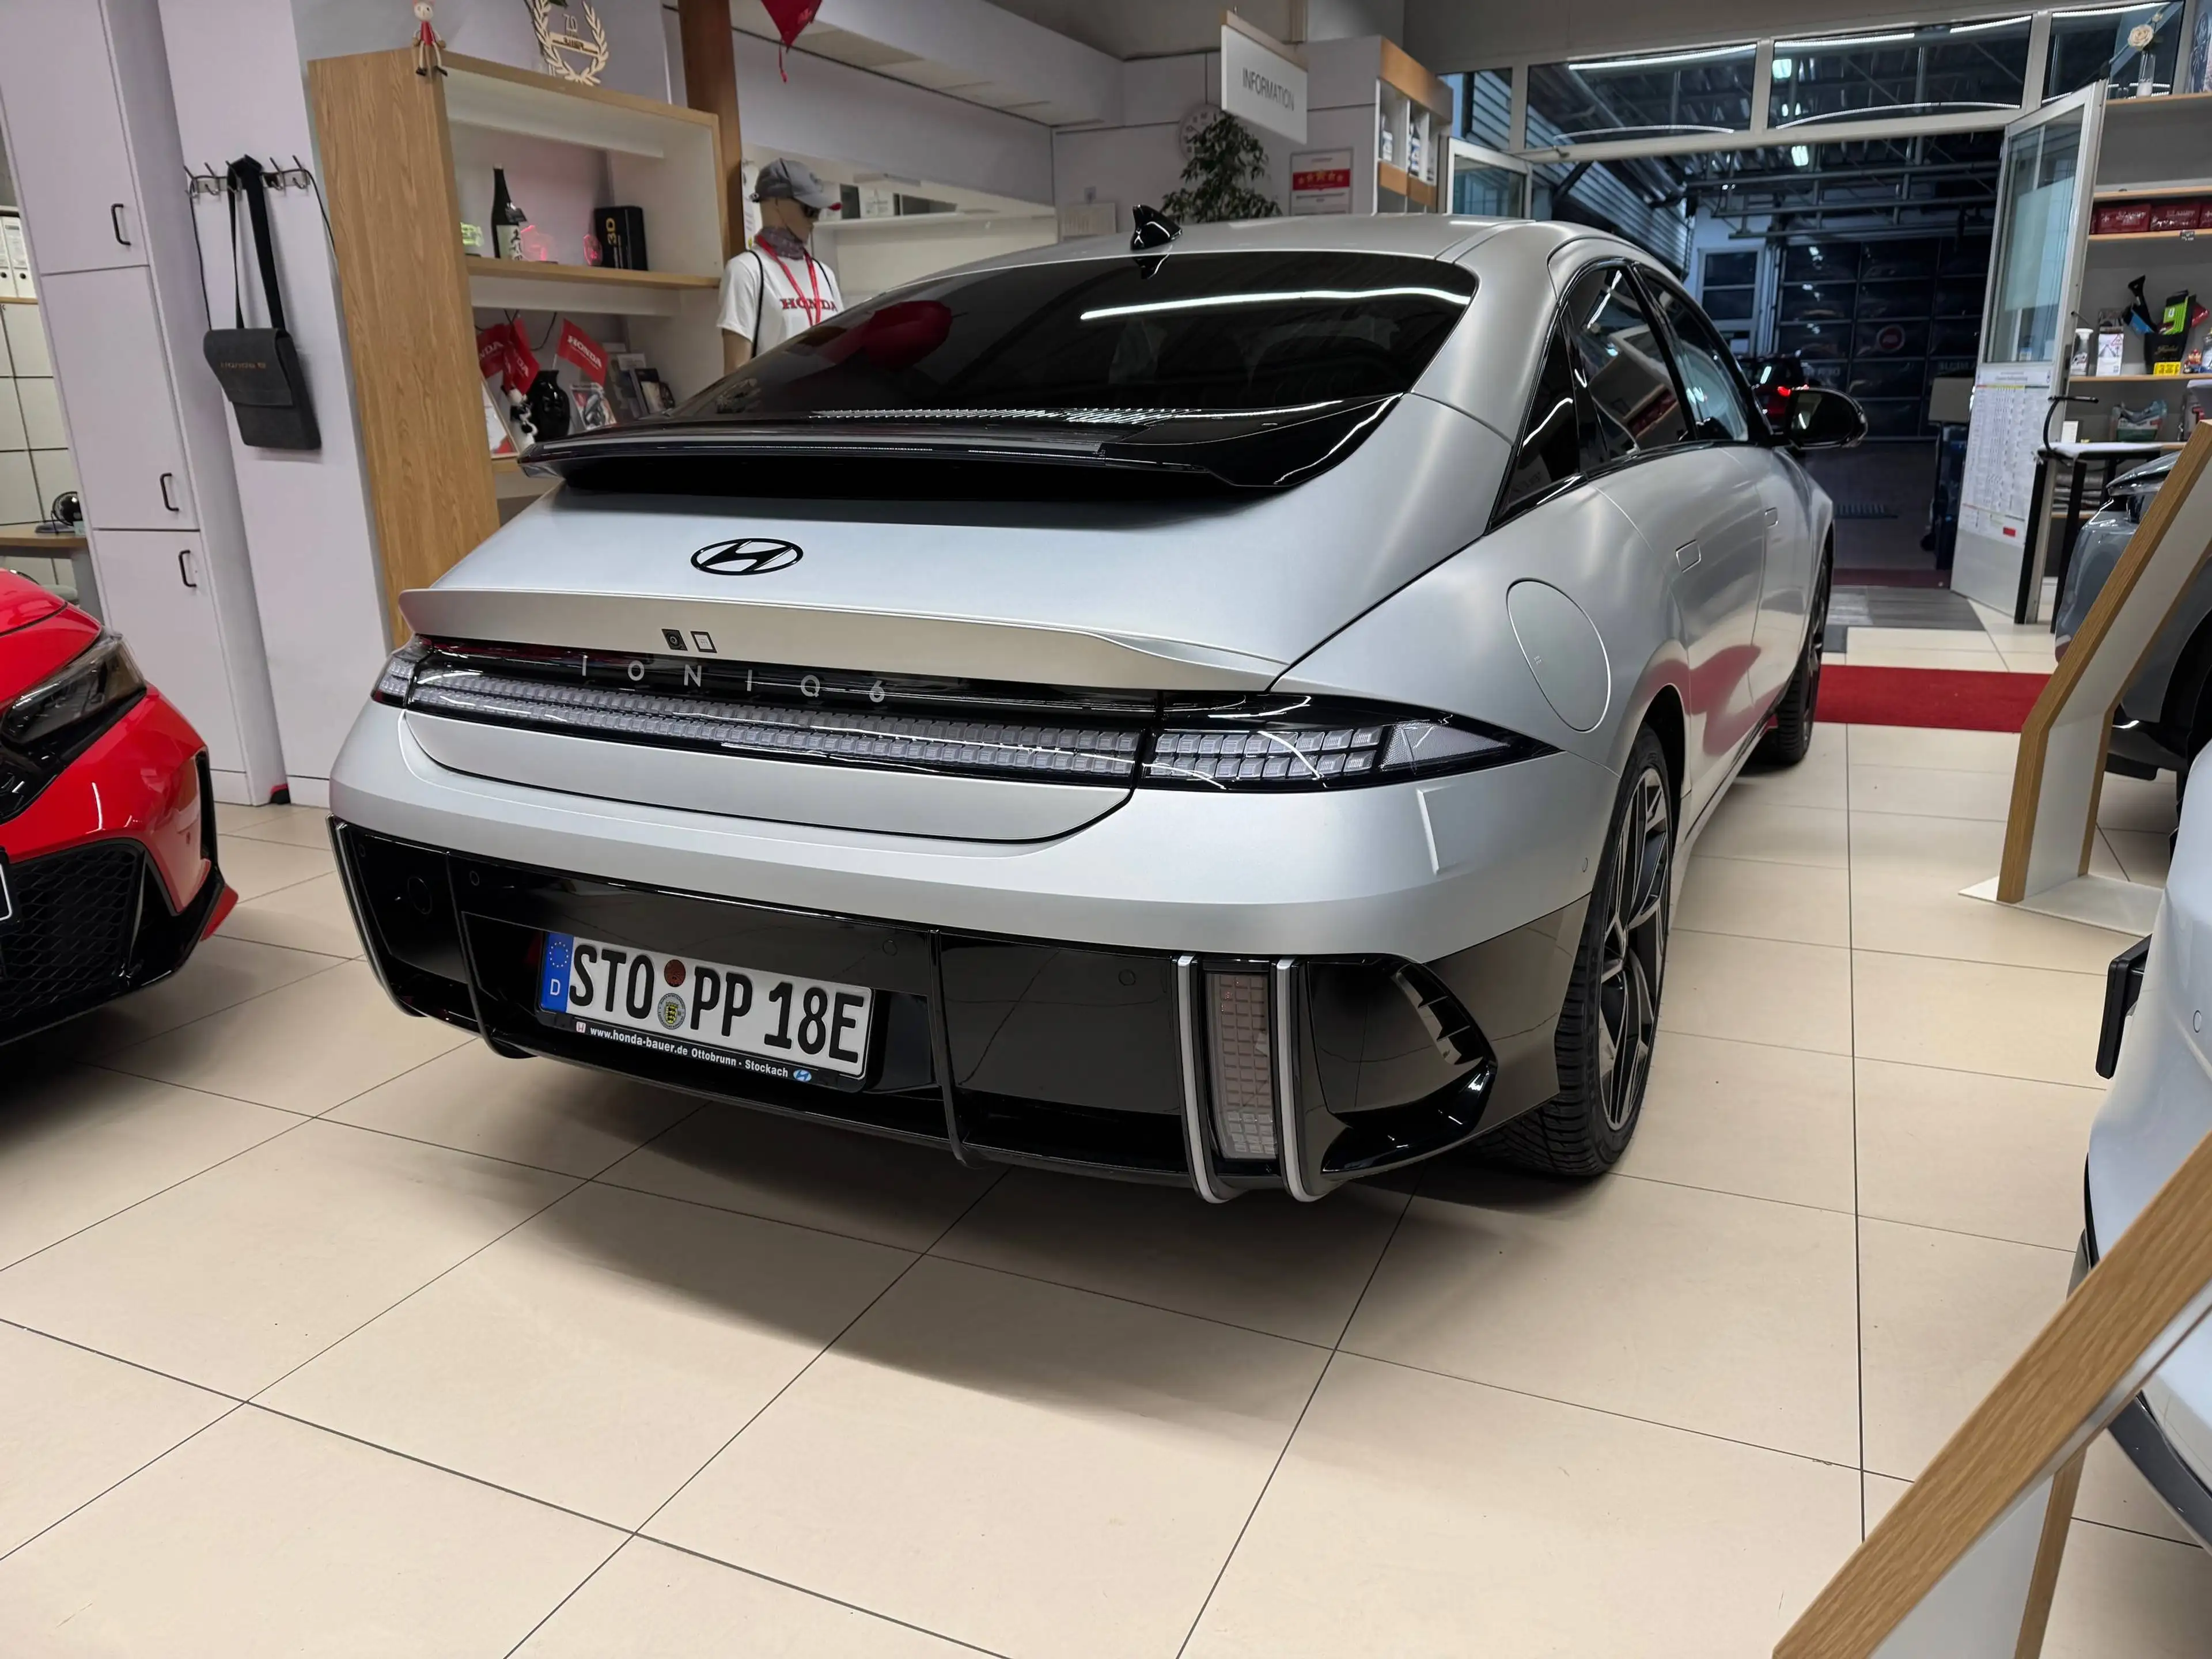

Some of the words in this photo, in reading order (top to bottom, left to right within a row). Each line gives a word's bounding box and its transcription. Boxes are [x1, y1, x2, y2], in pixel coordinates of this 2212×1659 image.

[1243, 67, 1294, 111] INFORMATION
[780, 298, 838, 312] HONDA
[567, 335, 603, 369] HONDA
[581, 654, 821, 698] IONIQ
[869, 679, 886, 703] 6
[550, 979, 561, 995] D
[569, 945, 654, 1020] STO
[690, 966, 753, 1037] PP
[764, 982, 864, 1063] 18E
[590, 1027, 688, 1055] www.honda-bauer.de
[691, 1048, 737, 1067] Ottobrunn
[745, 1059, 789, 1078] Stockach
